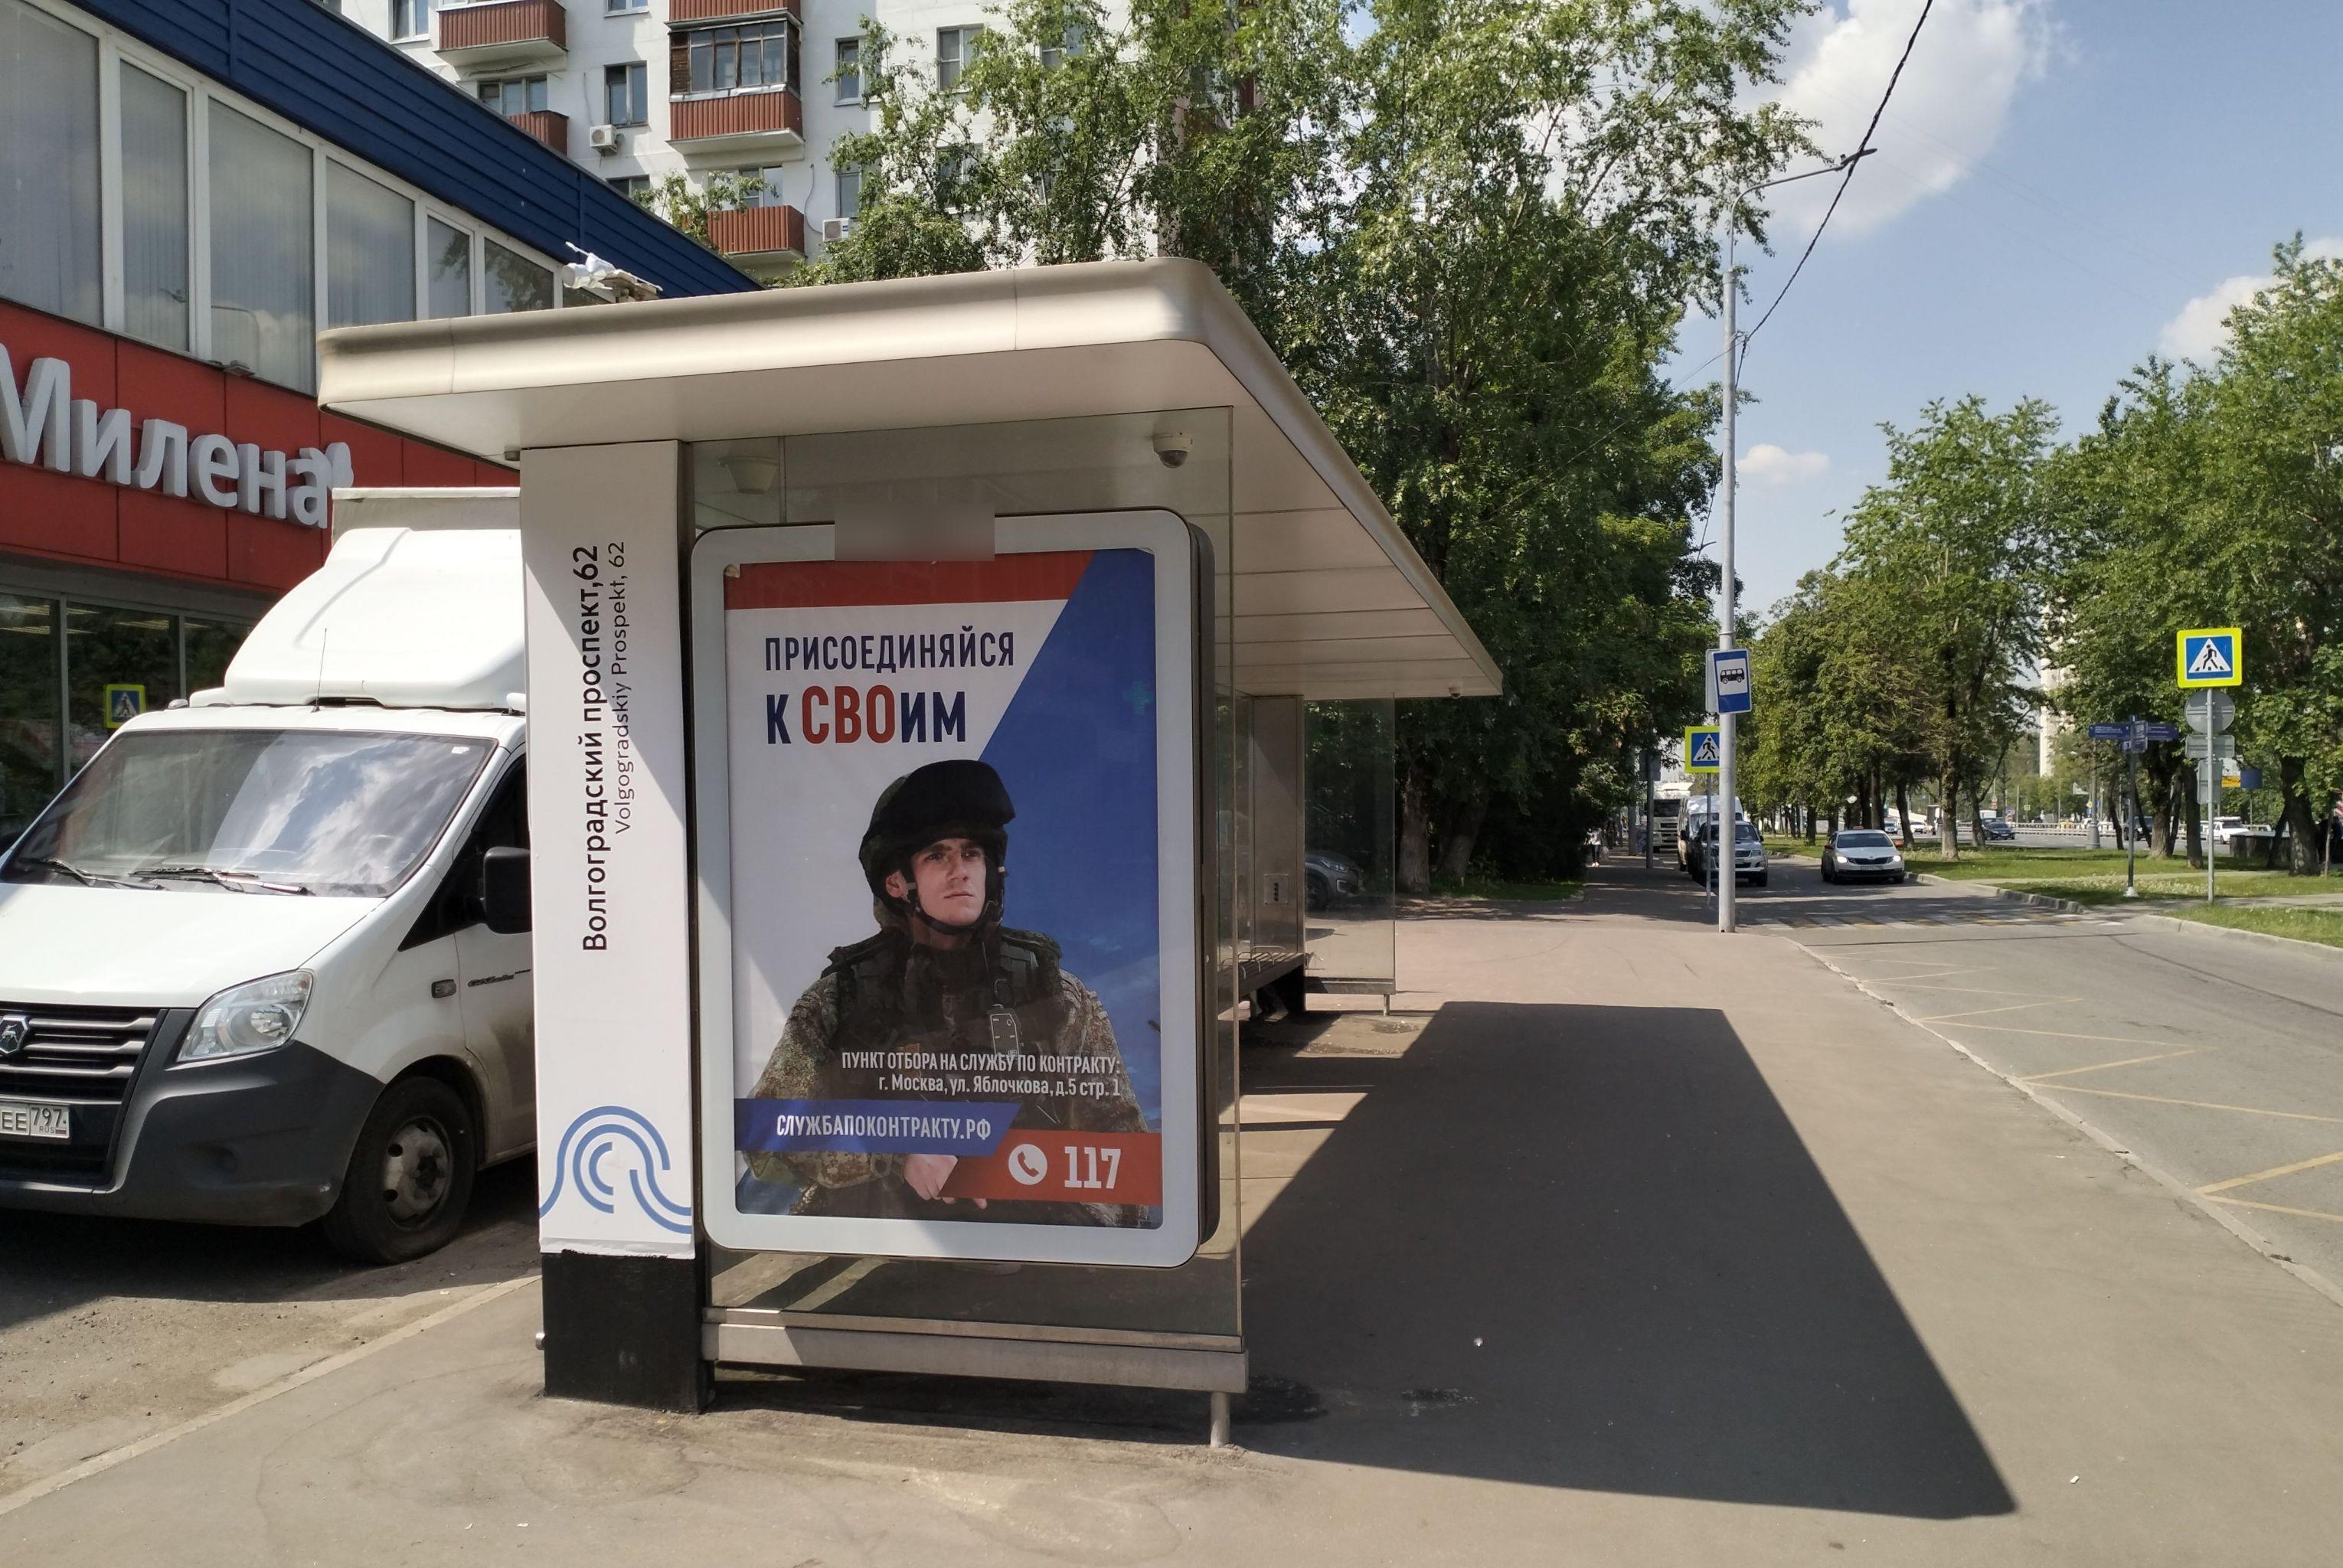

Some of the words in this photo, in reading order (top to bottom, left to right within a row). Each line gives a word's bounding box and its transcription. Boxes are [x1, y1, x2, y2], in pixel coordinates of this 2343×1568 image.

[0, 343, 328, 529] Милена
[608, 541, 625, 568] 62
[609, 575, 629, 675] Prospekt,
[765, 625, 1015, 673] ПРИСОЕДИНЯЙСЯ
[612, 682, 634, 834] Volgogradskiy
[577, 733, 611, 950] Волгоградский
[842, 1051, 885, 1069] ПУНКТ
[887, 1052, 938, 1070] ОТБОРА
[940, 1054, 957, 1070] НА
[960, 1054, 1016, 1071] СЛУЖБУ
[1018, 1054, 1036, 1072] ПО
[1040, 1055, 1120, 1074] КОНТРАКТУ:
[878, 1076, 888, 1090] г.
[892, 1073, 948, 1095] Москва,
[949, 1077, 970, 1096] ул.
[973, 1076, 1054, 1096] Яблочкова,
[1055, 1079, 1077, 1096] д.5
[1080, 1081, 1109, 1099] стр.
[1113, 1079, 1120, 1096] 1
[31, 1107, 62, 1128] 797
[776, 1114, 992, 1141] СЛУЖБАПОКОНТРАКТУ.РФ
[1064, 1146, 1121, 1190] 117
